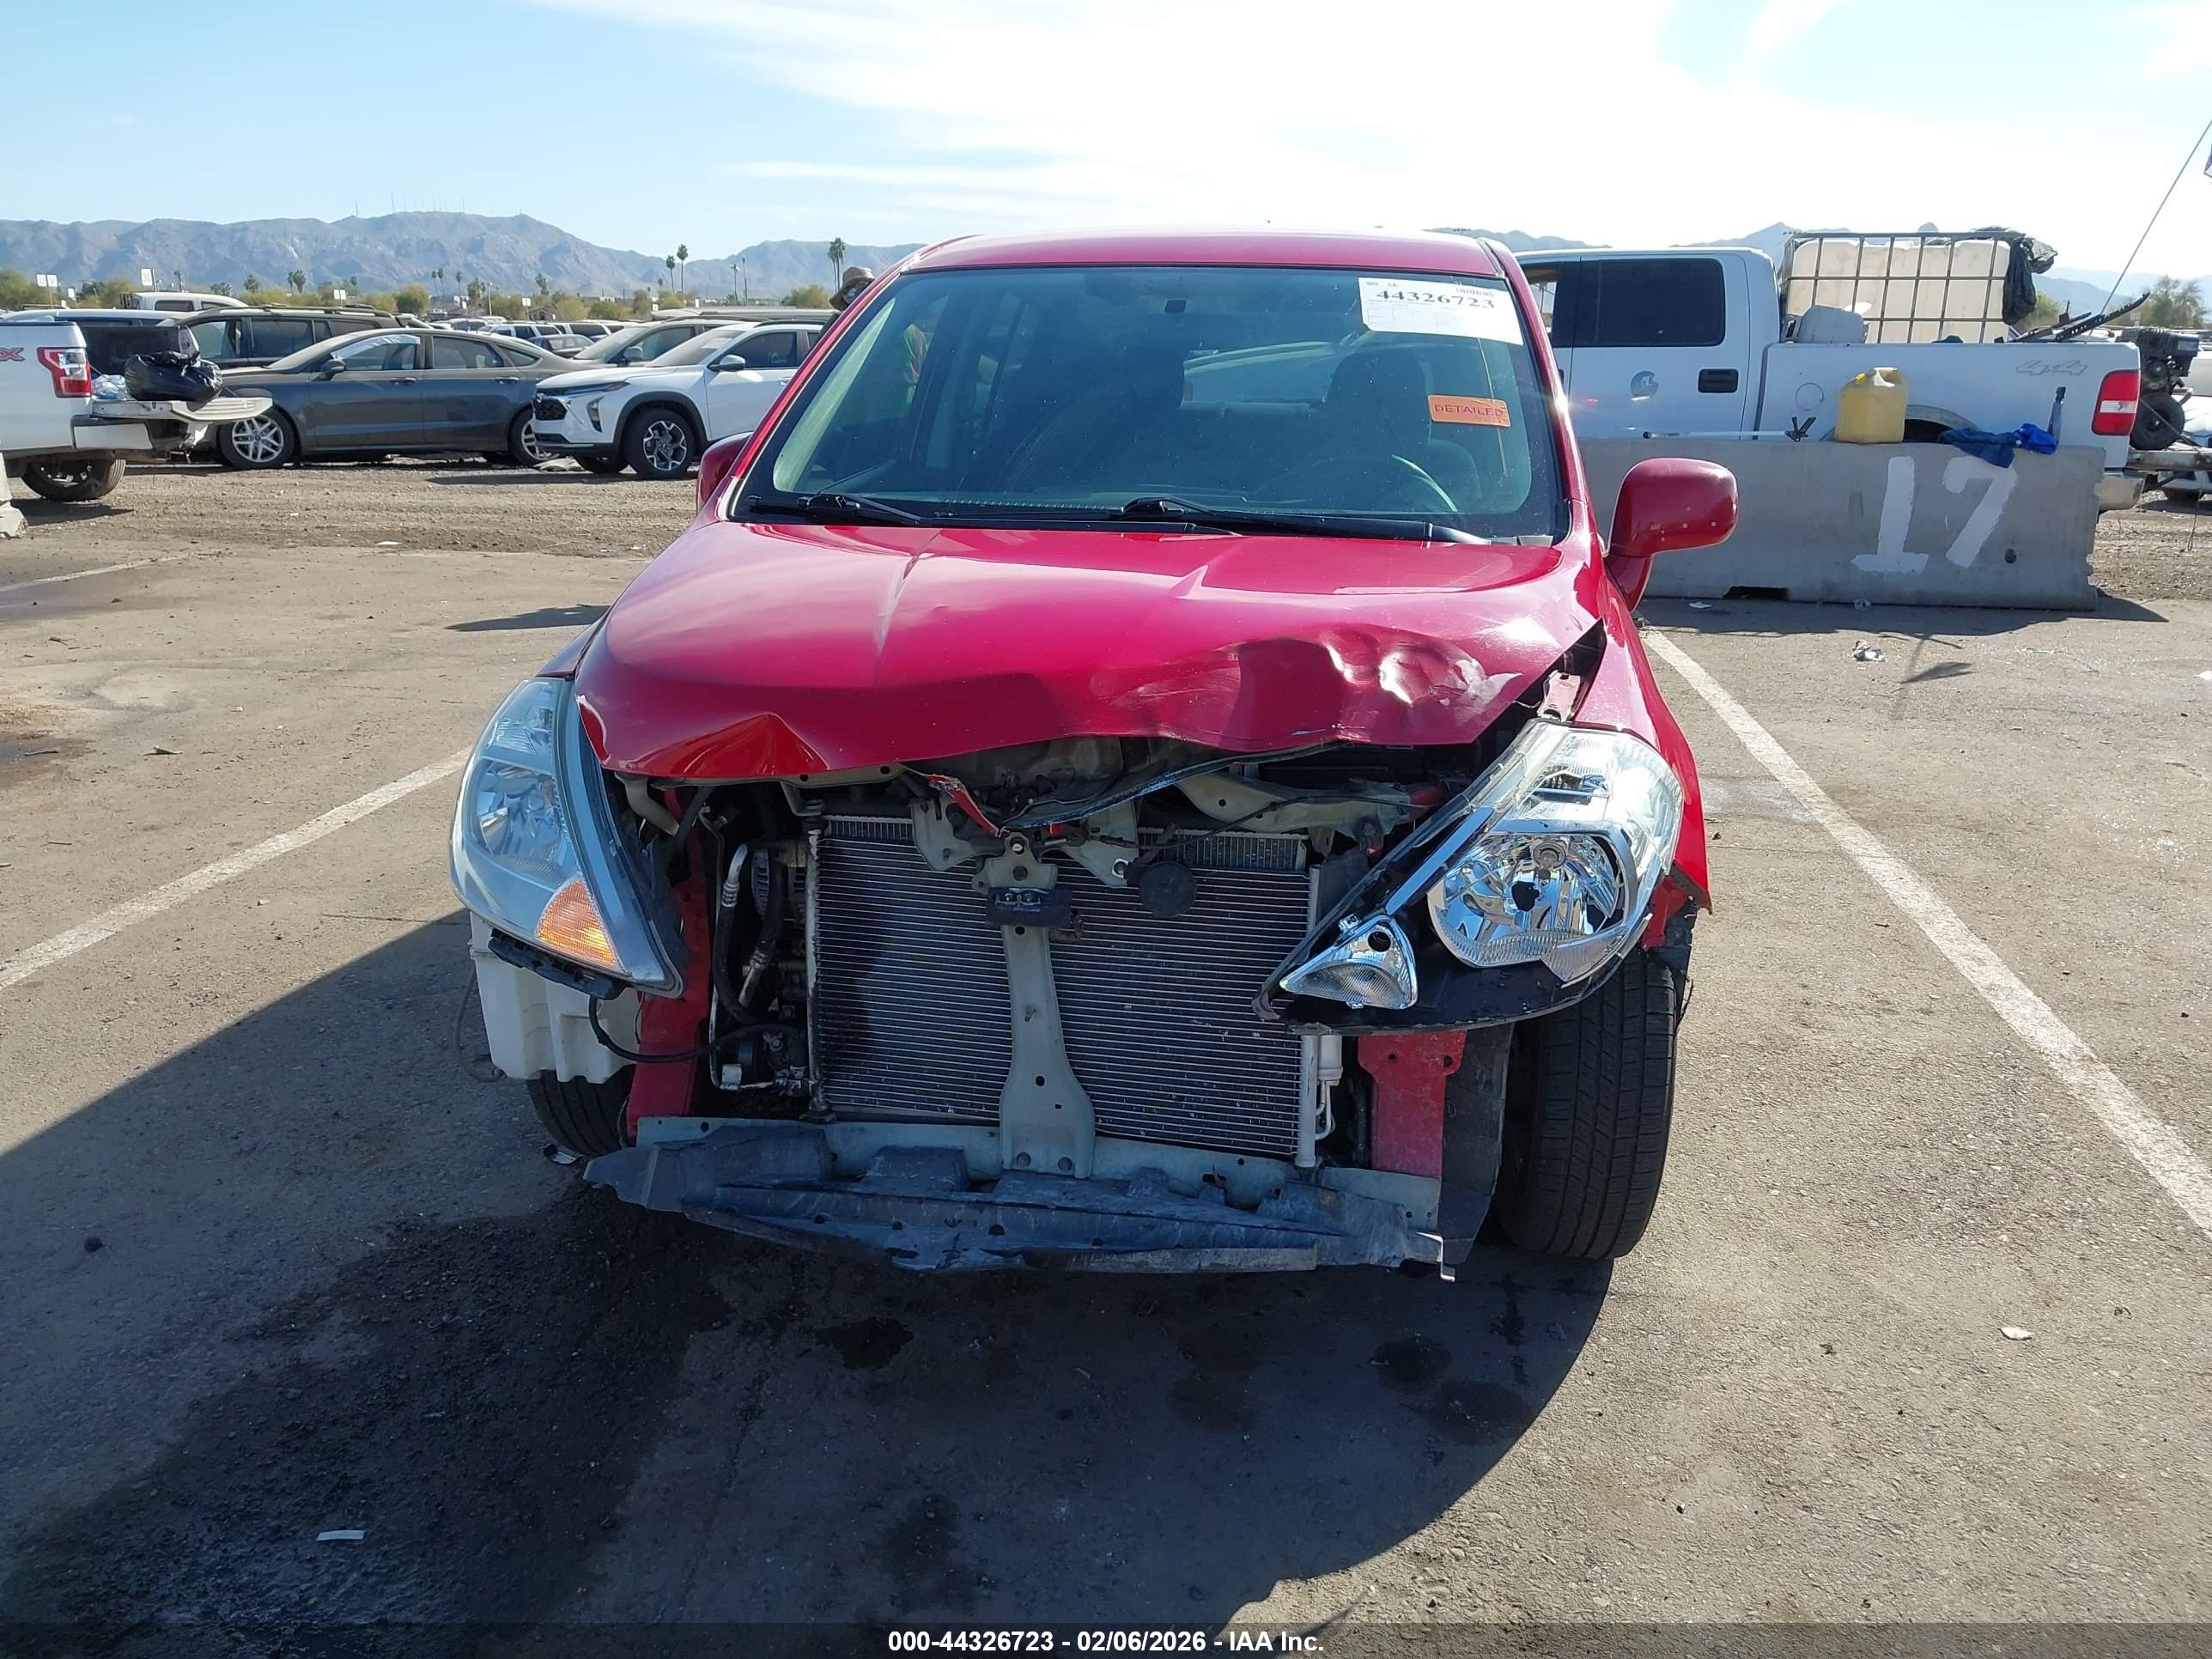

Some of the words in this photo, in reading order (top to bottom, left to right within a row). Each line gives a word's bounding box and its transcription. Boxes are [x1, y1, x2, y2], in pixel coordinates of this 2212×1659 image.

[1376, 289, 1496, 309] 44326723
[1434, 404, 1504, 416] DETAILED
[1850, 454, 2019, 574] 17
